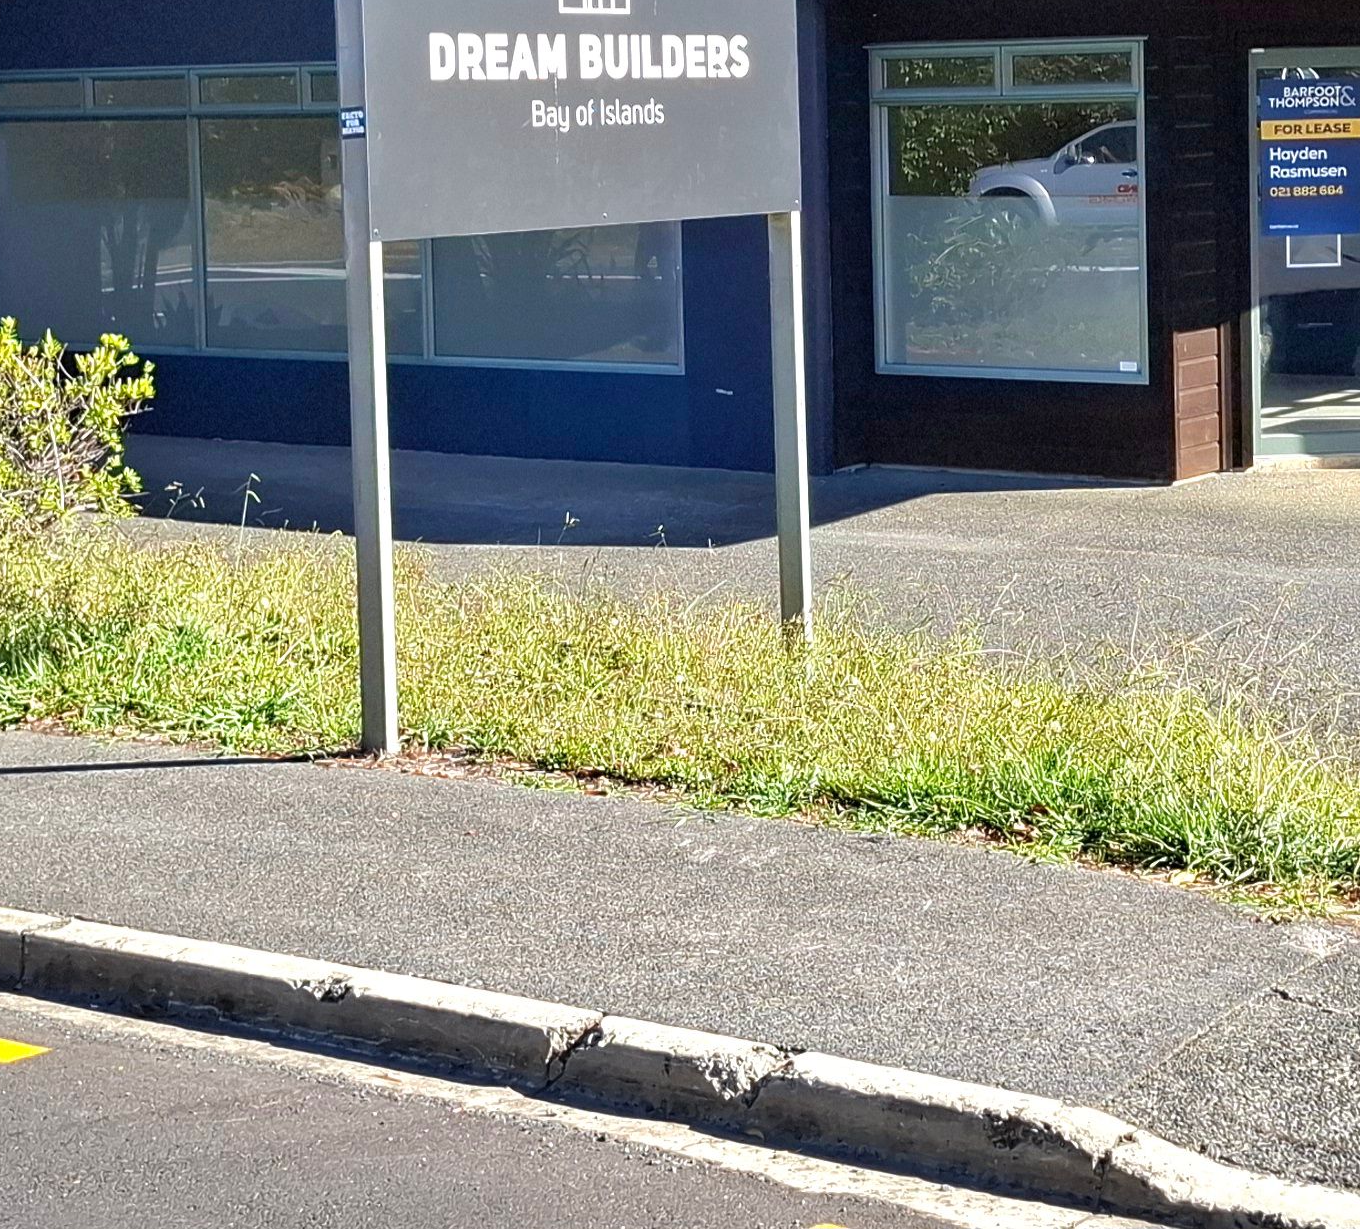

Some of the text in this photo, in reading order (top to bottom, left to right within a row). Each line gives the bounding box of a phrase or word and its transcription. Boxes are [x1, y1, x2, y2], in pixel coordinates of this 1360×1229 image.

[429, 32, 750, 81] DREAM BUILDERS
[1283, 86, 1341, 98] BARFOOT
[1268, 97, 1340, 109] THOMPSON
[532, 97, 665, 133] Bay of Islands
[1274, 123, 1351, 135] FOR LEASE
[1269, 146, 1328, 164] Hayden
[1270, 165, 1347, 179] Rasmusen
[1270, 187, 1292, 197] 021
